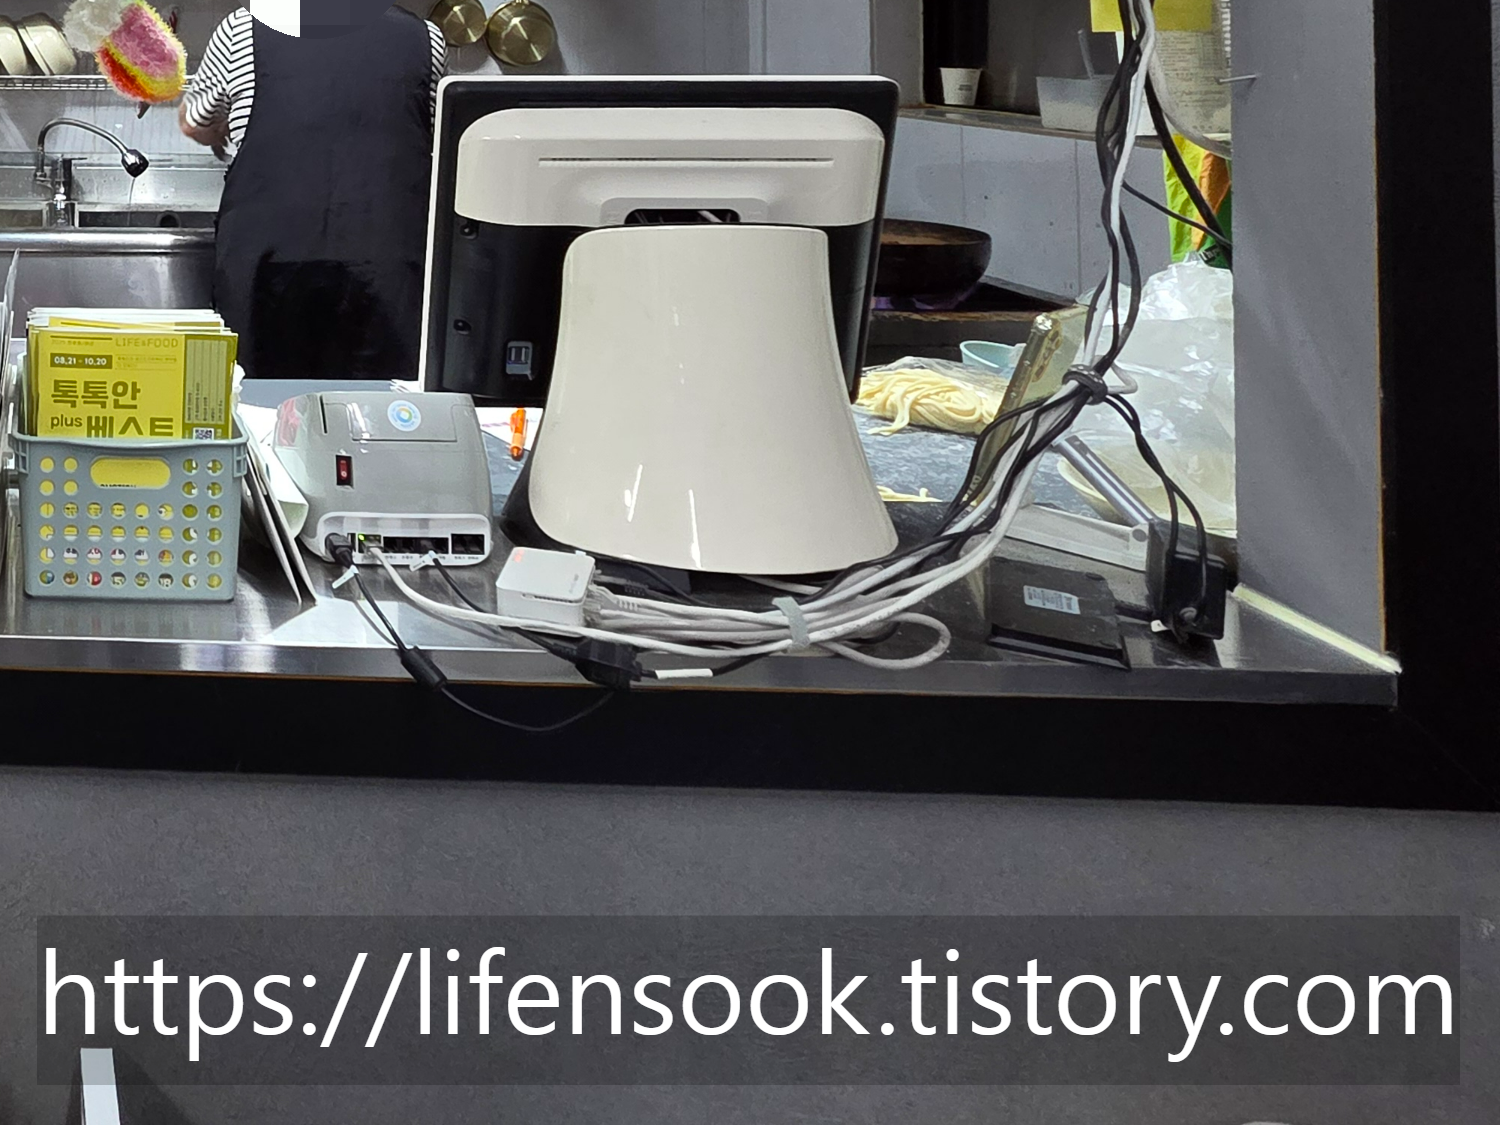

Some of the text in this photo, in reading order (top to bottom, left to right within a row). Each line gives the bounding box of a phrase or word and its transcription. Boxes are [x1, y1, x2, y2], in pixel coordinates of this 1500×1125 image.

[53, 356, 77, 365] 08.21
[84, 357, 107, 366] 10.20
[51, 379, 141, 409] 톡톡안
[51, 414, 83, 429] plus
